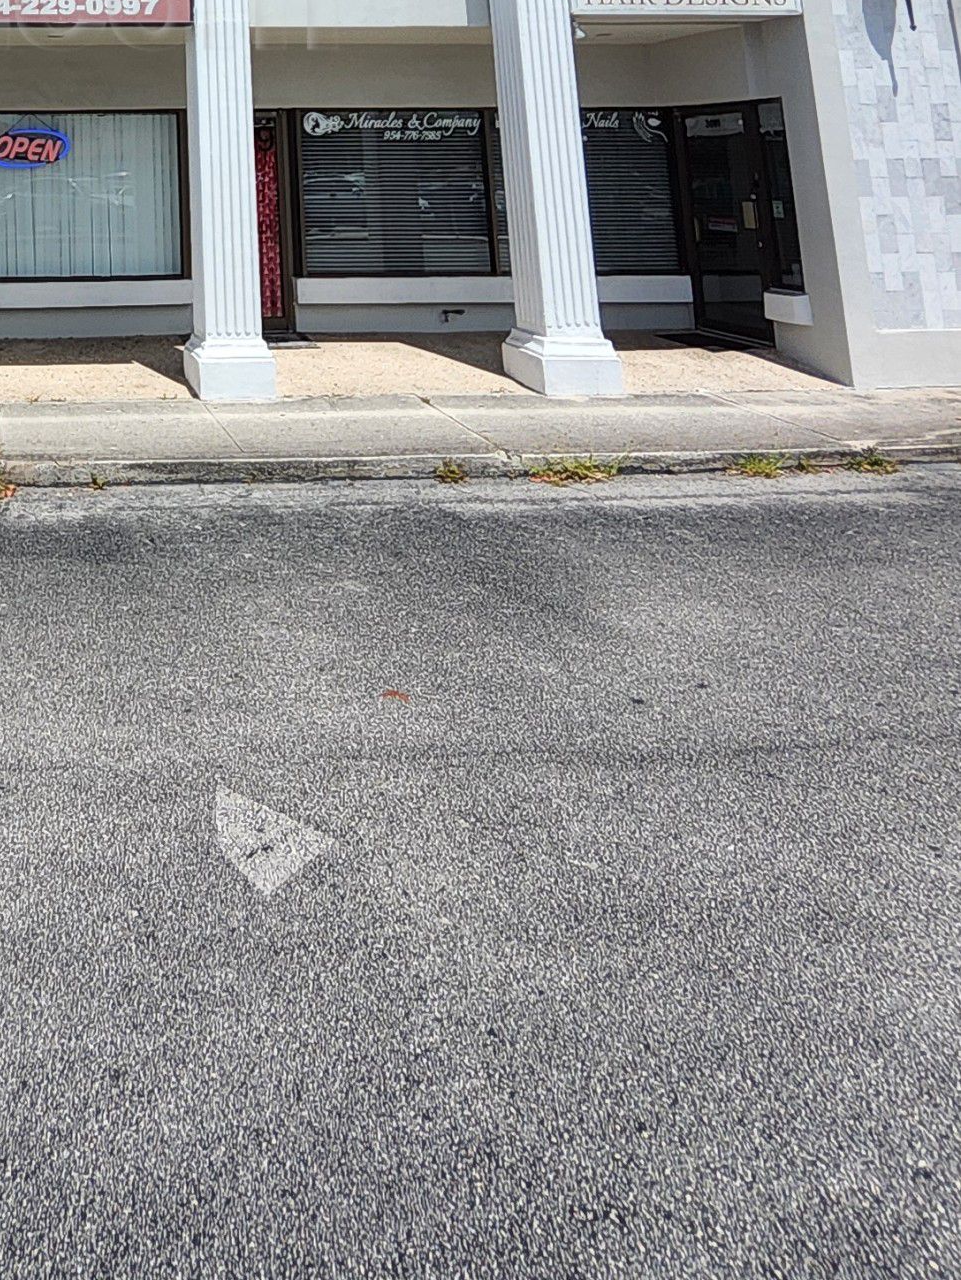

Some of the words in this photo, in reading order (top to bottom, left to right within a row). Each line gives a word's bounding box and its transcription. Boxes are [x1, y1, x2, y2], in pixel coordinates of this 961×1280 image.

[344, 112, 404, 130] Miracles
[408, 114, 421, 129] &
[423, 112, 481, 136] Company
[582, 112, 620, 129] Nails
